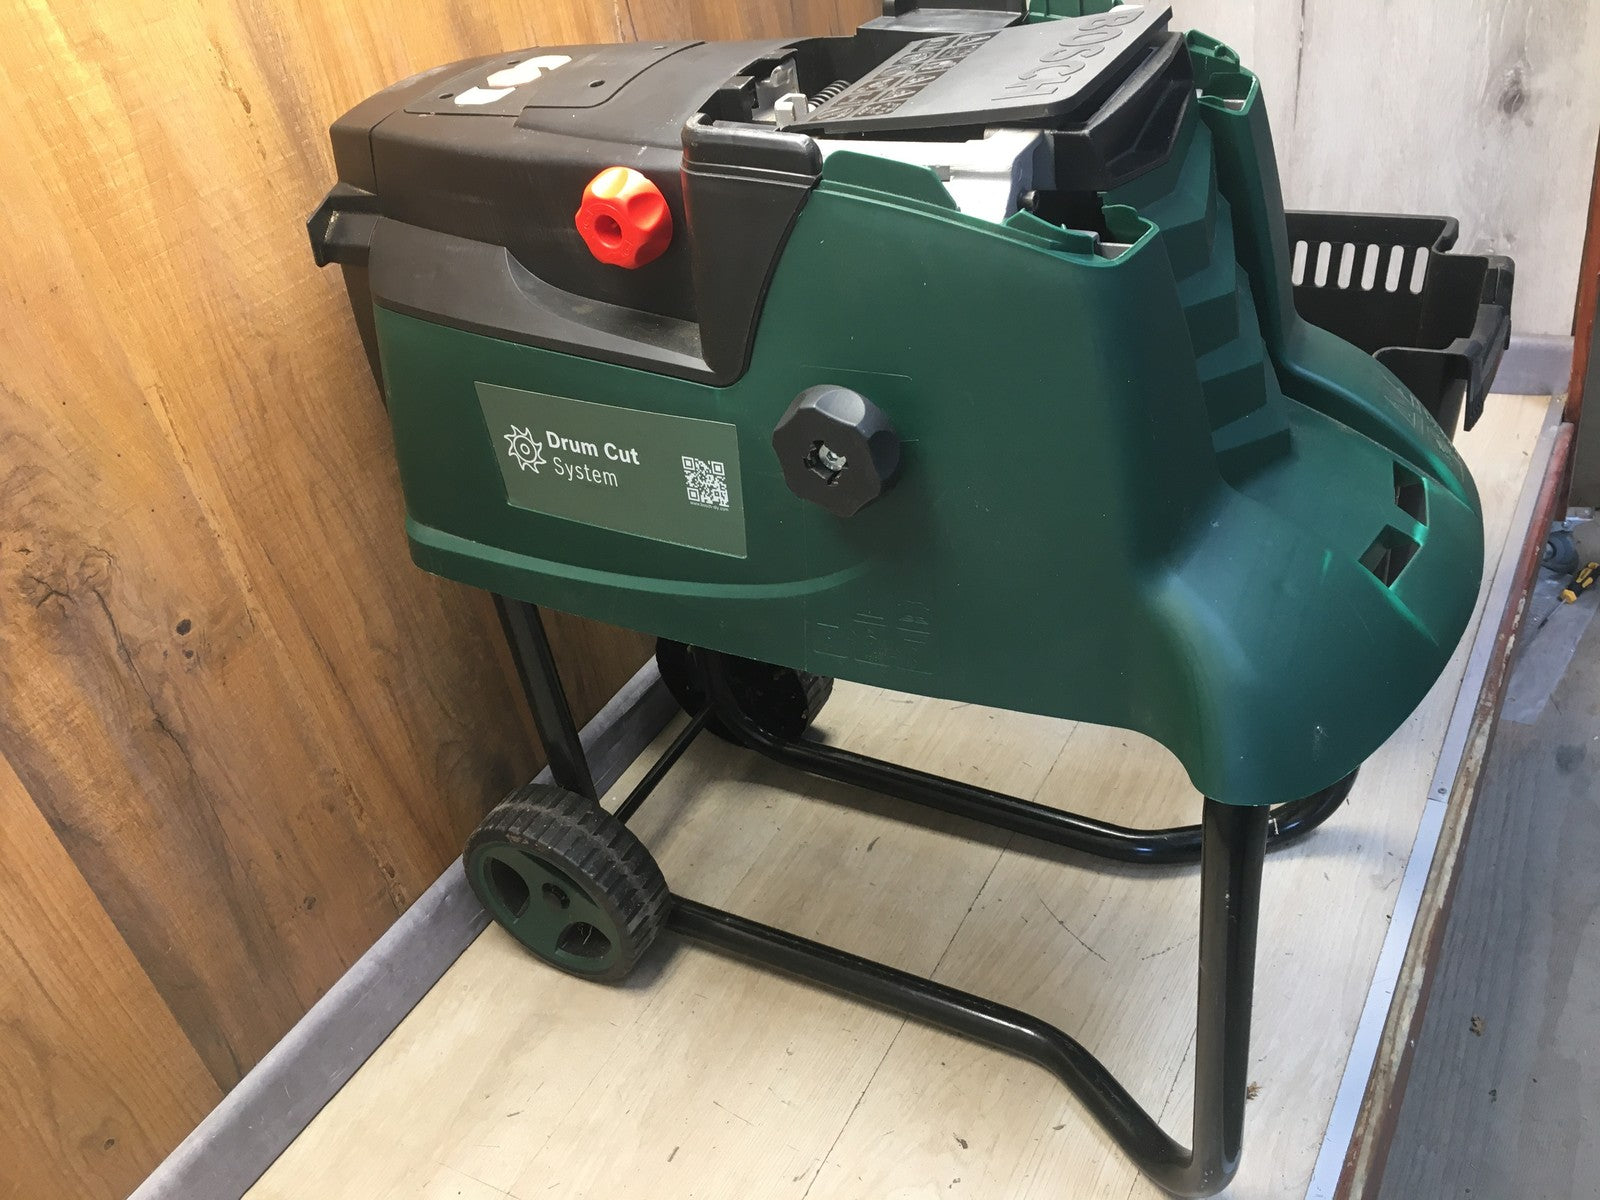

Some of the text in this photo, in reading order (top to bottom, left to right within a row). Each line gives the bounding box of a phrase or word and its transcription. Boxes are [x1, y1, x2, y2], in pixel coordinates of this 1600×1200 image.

[990, 9, 1145, 101] BOSCH
[546, 430, 640, 465] Drum Cut
[552, 456, 619, 488] System
